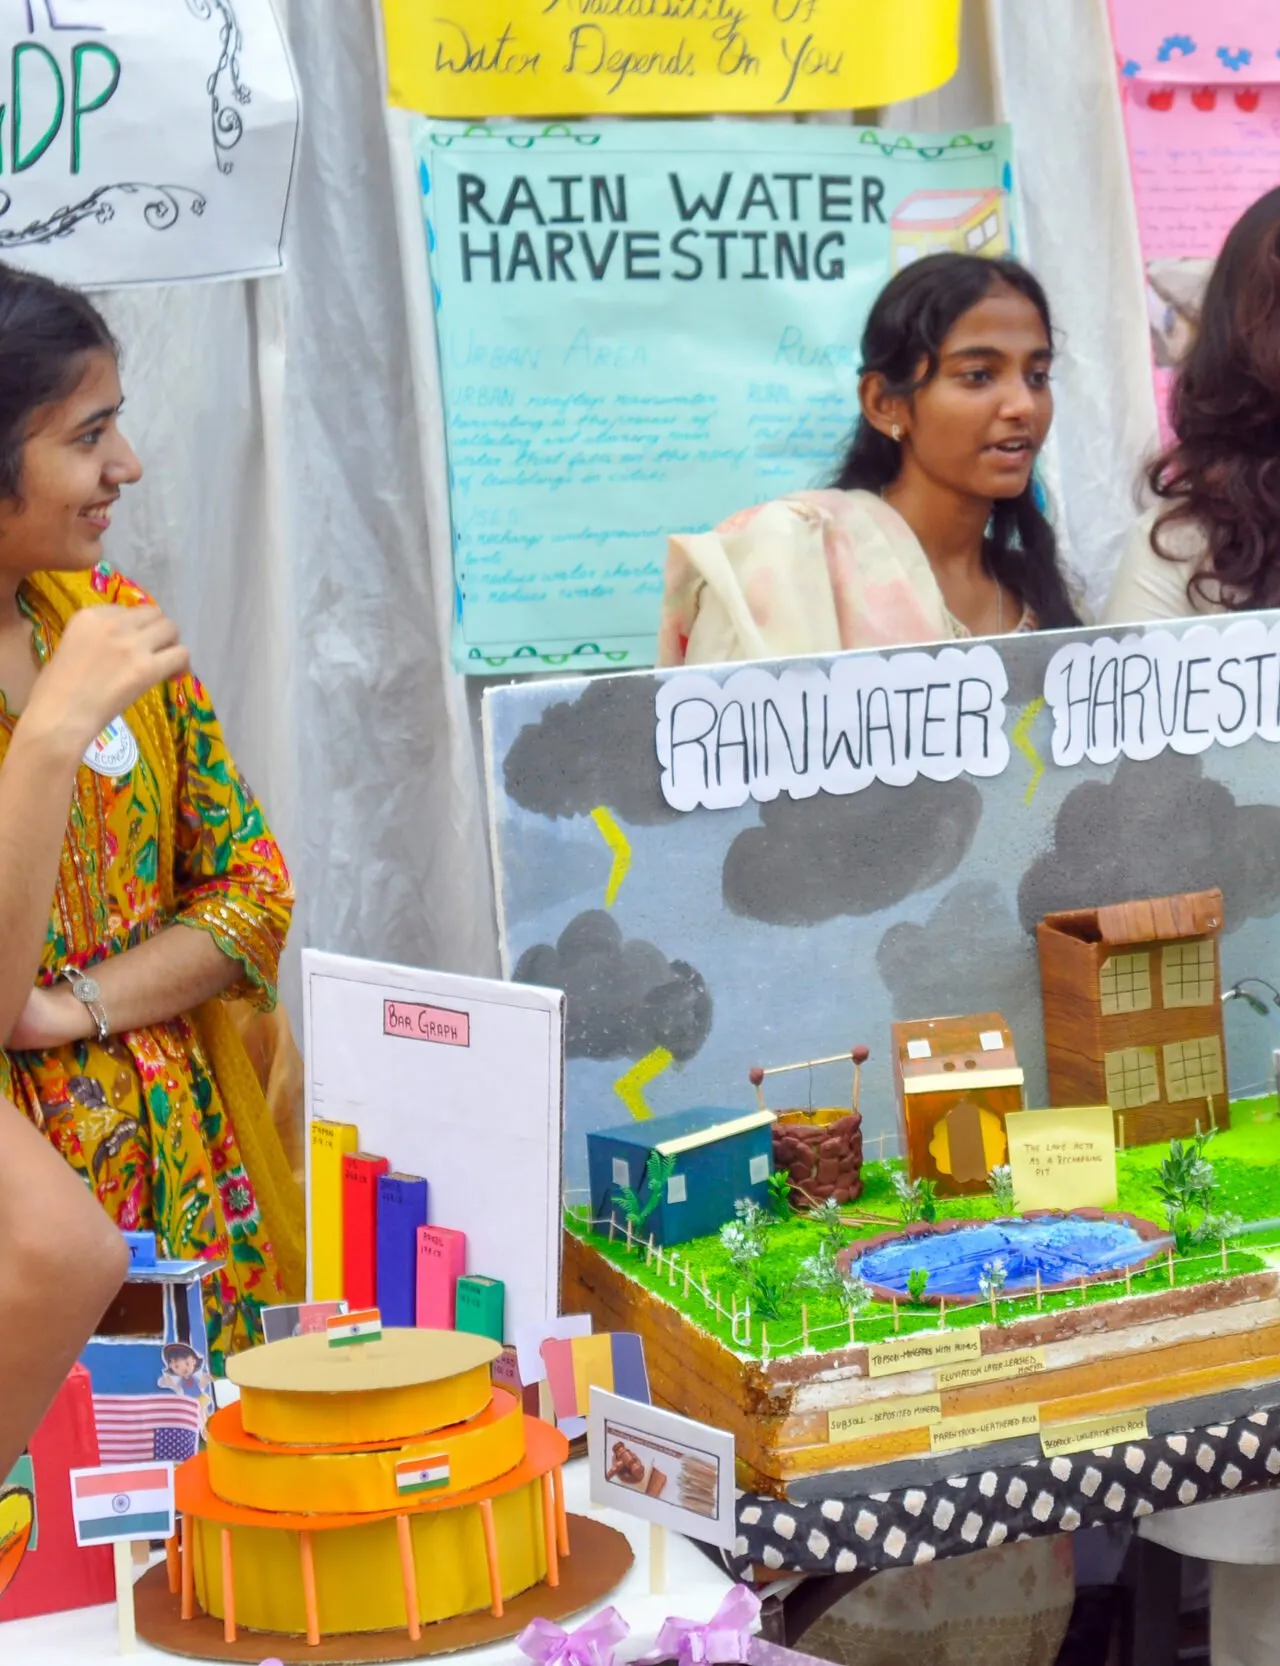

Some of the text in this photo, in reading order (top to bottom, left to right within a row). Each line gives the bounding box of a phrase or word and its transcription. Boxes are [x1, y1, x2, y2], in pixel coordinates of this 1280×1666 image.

[433, 17, 845, 104] Water Depends On You
[0, 40, 122, 176] DP
[457, 171, 887, 226] RAIN WATER
[459, 228, 846, 283] HARVESTING
[417, 1009, 458, 1040] GRAPH
